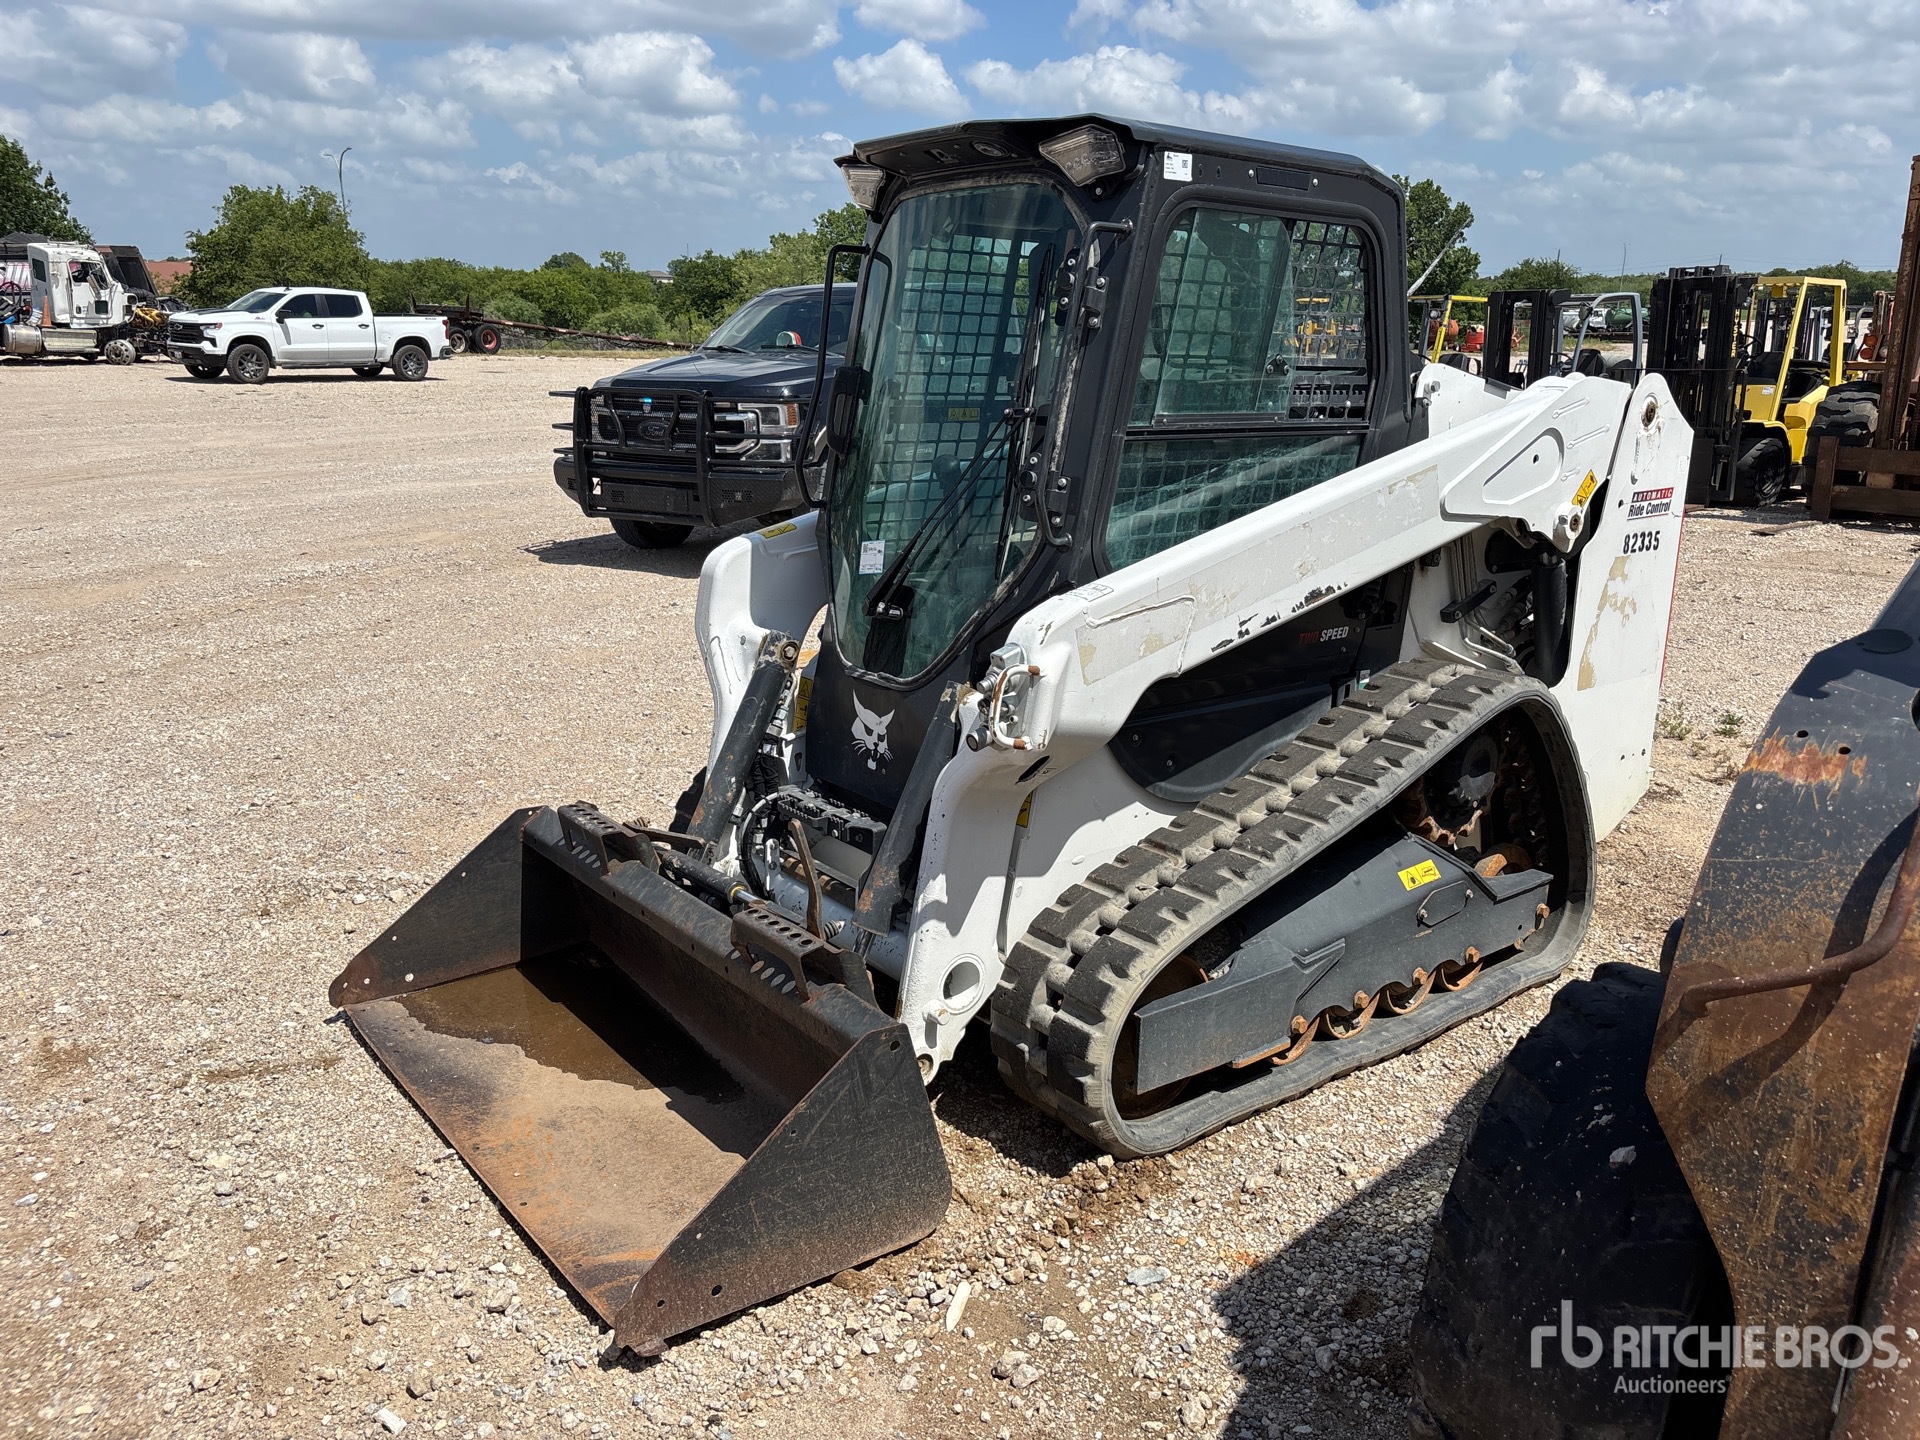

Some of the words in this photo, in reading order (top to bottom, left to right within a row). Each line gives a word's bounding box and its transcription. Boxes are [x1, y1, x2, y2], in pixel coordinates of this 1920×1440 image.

[1633, 489, 1673, 501] AUTOMATIC
[1628, 504, 1644, 517] Ride
[1646, 500, 1671, 515] Control
[1623, 530, 1660, 554] 82335
[1320, 626, 1349, 642] SPEED
